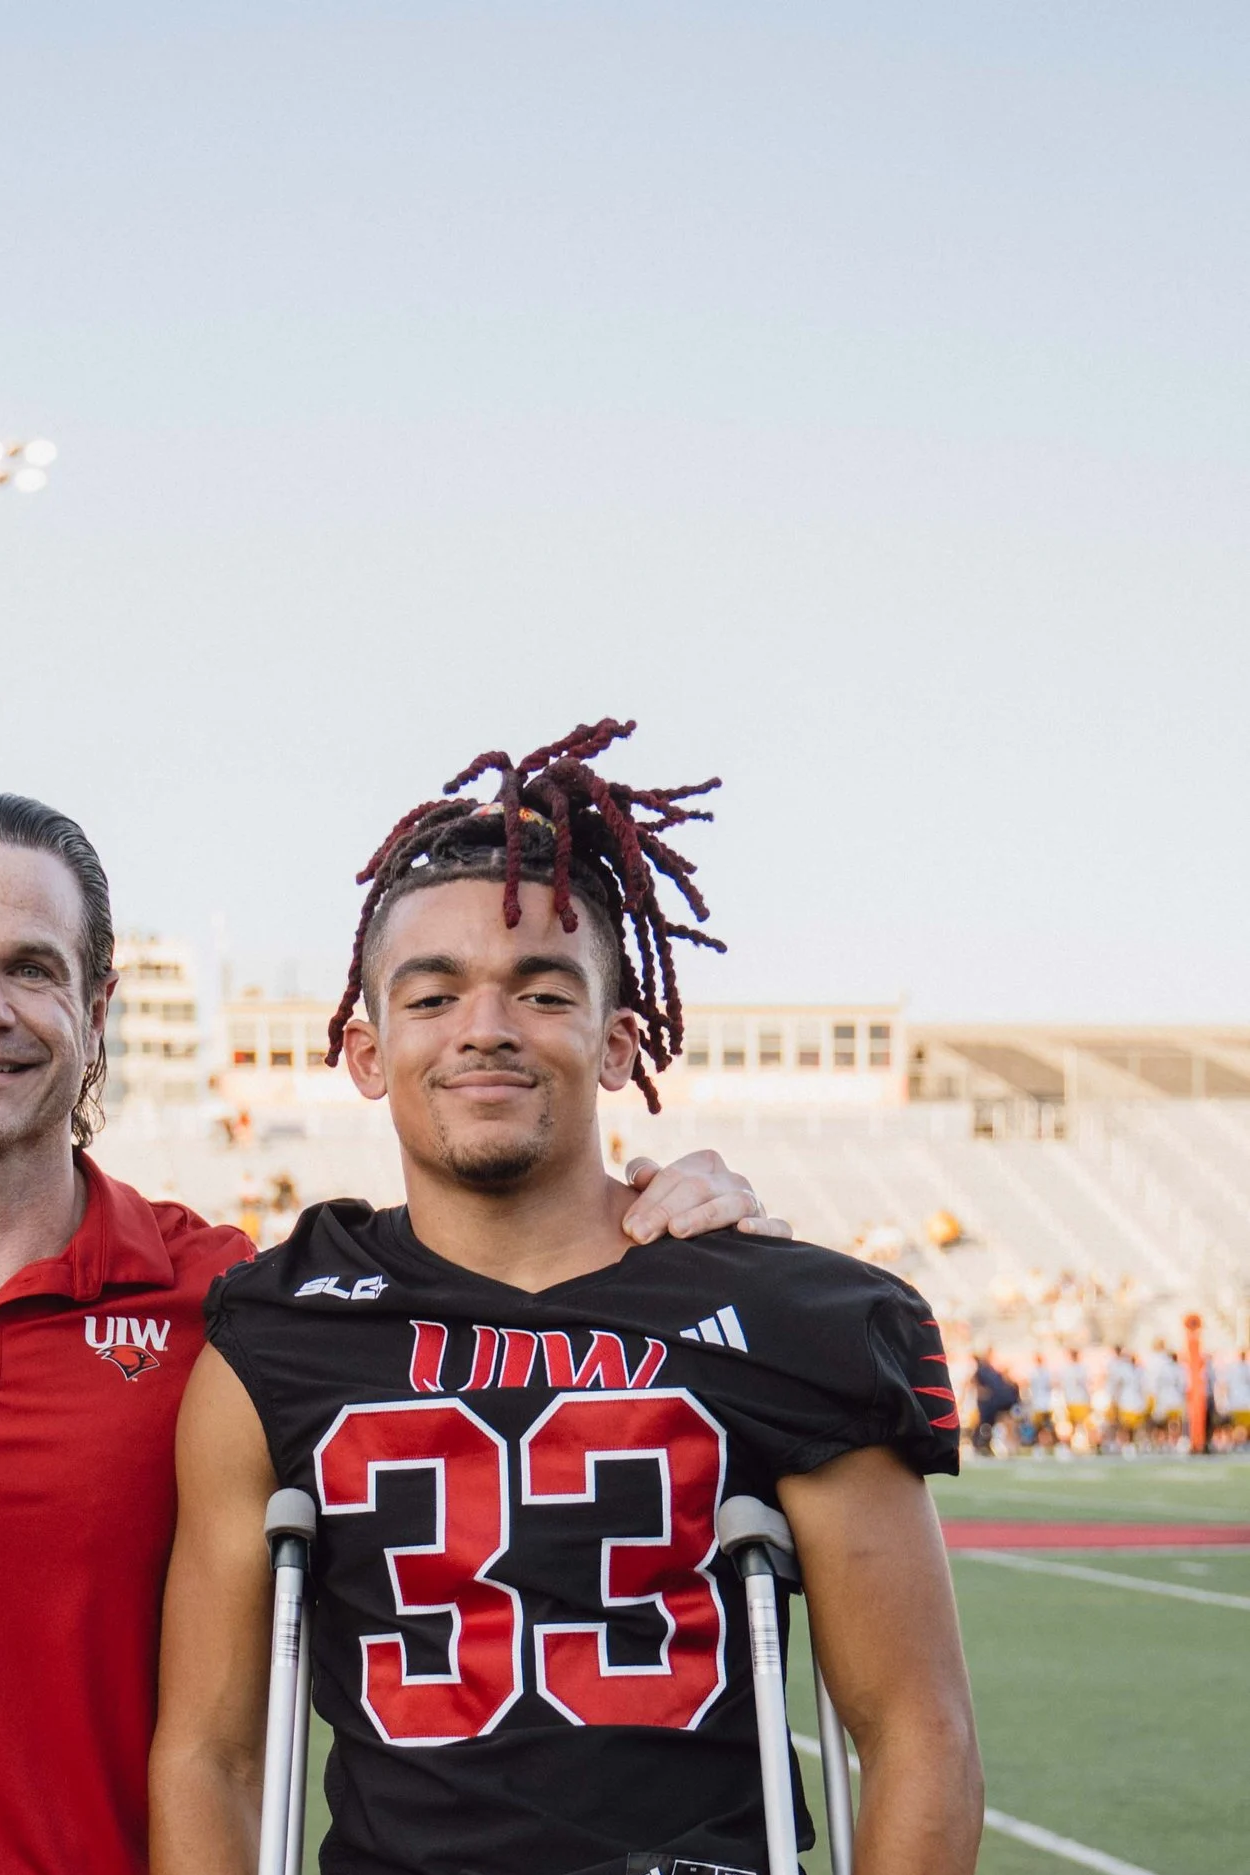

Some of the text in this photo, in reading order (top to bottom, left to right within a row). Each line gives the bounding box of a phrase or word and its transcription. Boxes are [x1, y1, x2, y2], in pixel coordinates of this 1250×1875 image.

[83, 1315, 171, 1352] UIW
[408, 1319, 668, 1392] UIW
[313, 1387, 729, 1748] 33
